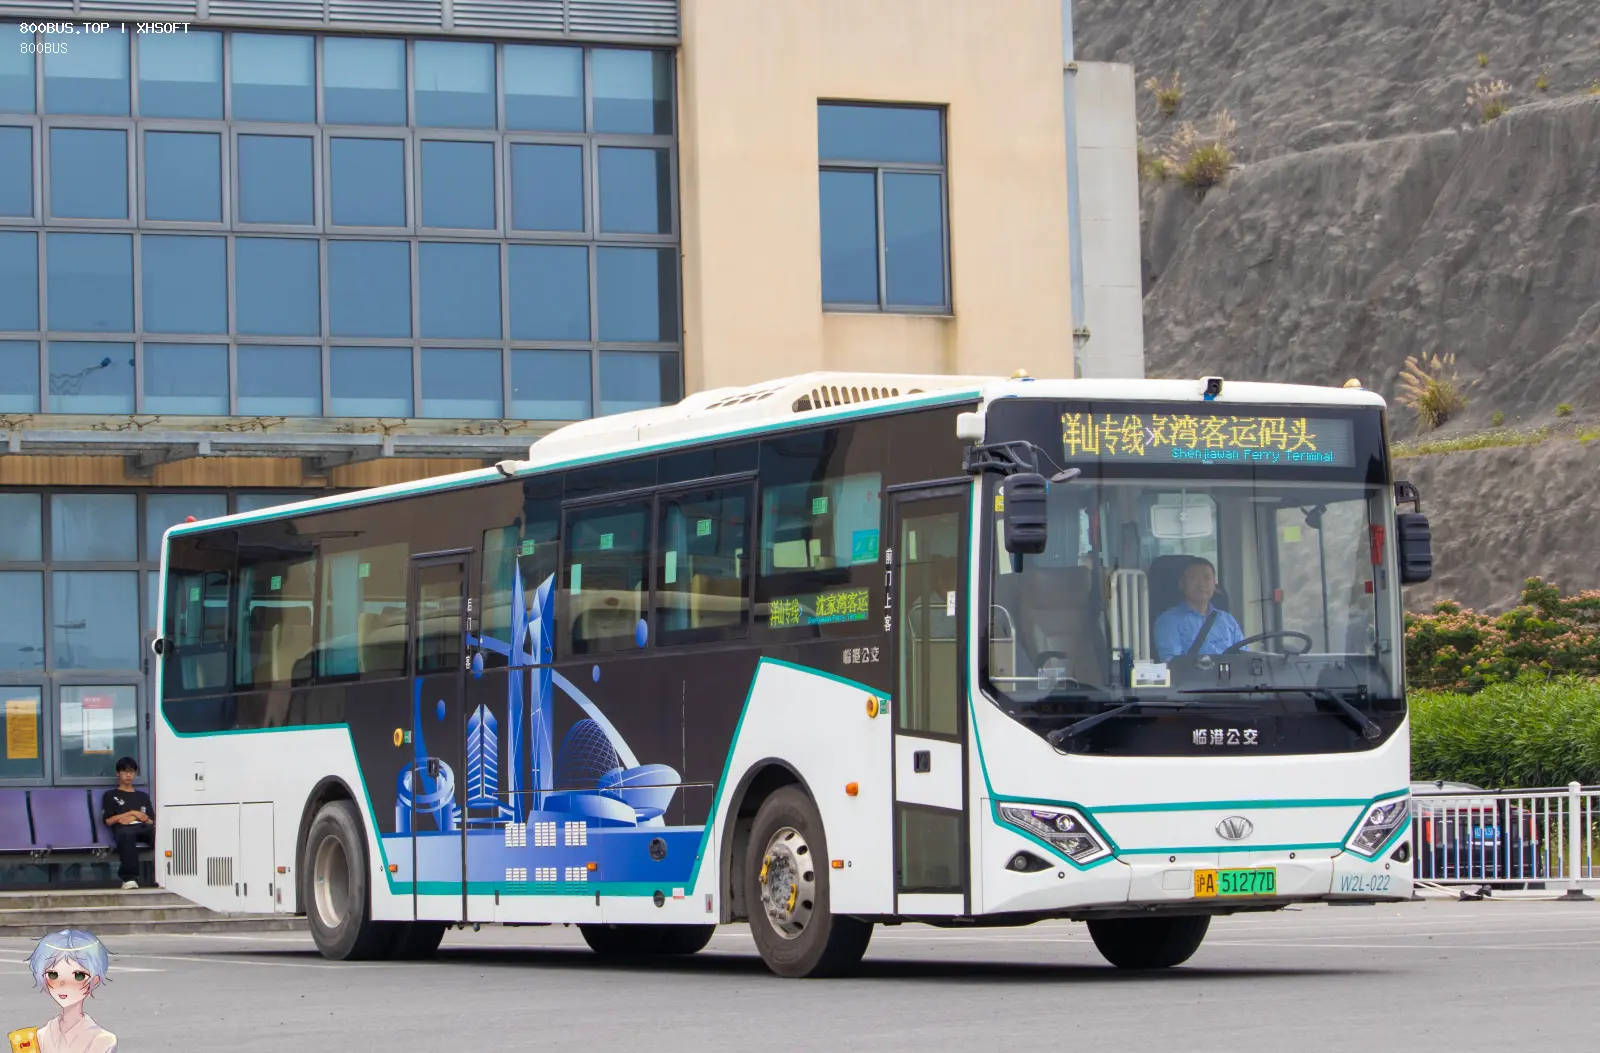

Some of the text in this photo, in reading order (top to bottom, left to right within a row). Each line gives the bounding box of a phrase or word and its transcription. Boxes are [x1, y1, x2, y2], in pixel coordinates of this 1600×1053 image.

[1171, 448, 1333, 463] Shenjiawan Ferry Terminal
[842, 647, 880, 665] 临港公交
[1192, 728, 1259, 746] 临港公交
[1341, 875, 1390, 892] W2L-022
